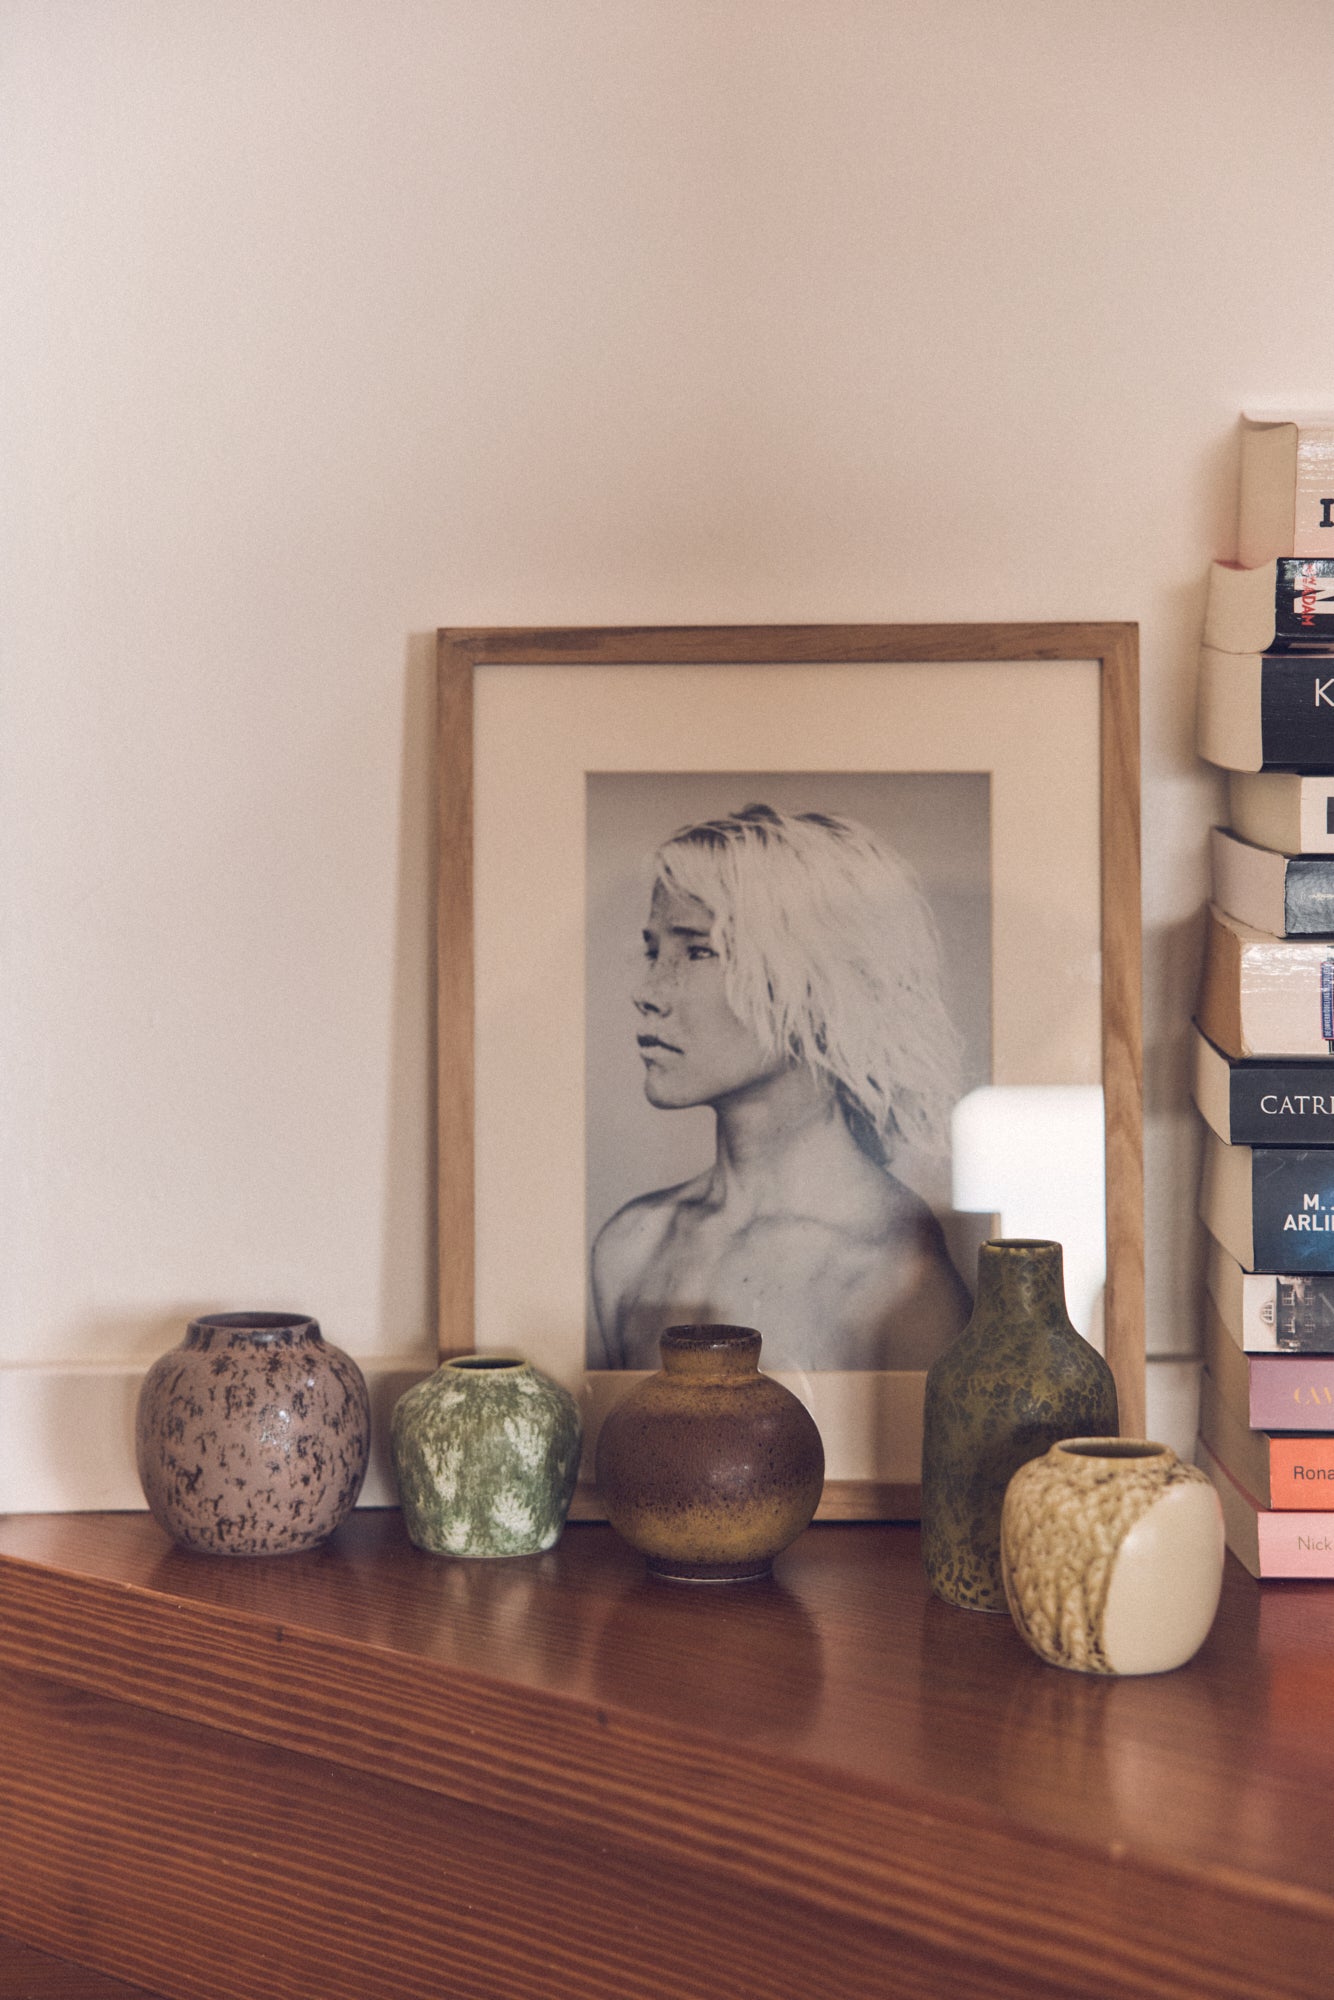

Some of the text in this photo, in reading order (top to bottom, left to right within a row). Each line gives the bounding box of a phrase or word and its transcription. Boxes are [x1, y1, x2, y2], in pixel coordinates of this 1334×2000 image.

[1283, 1214, 1334, 1231] ARLI
[1293, 1465, 1334, 1480] Rona
[1297, 1535, 1332, 1551] Nick
